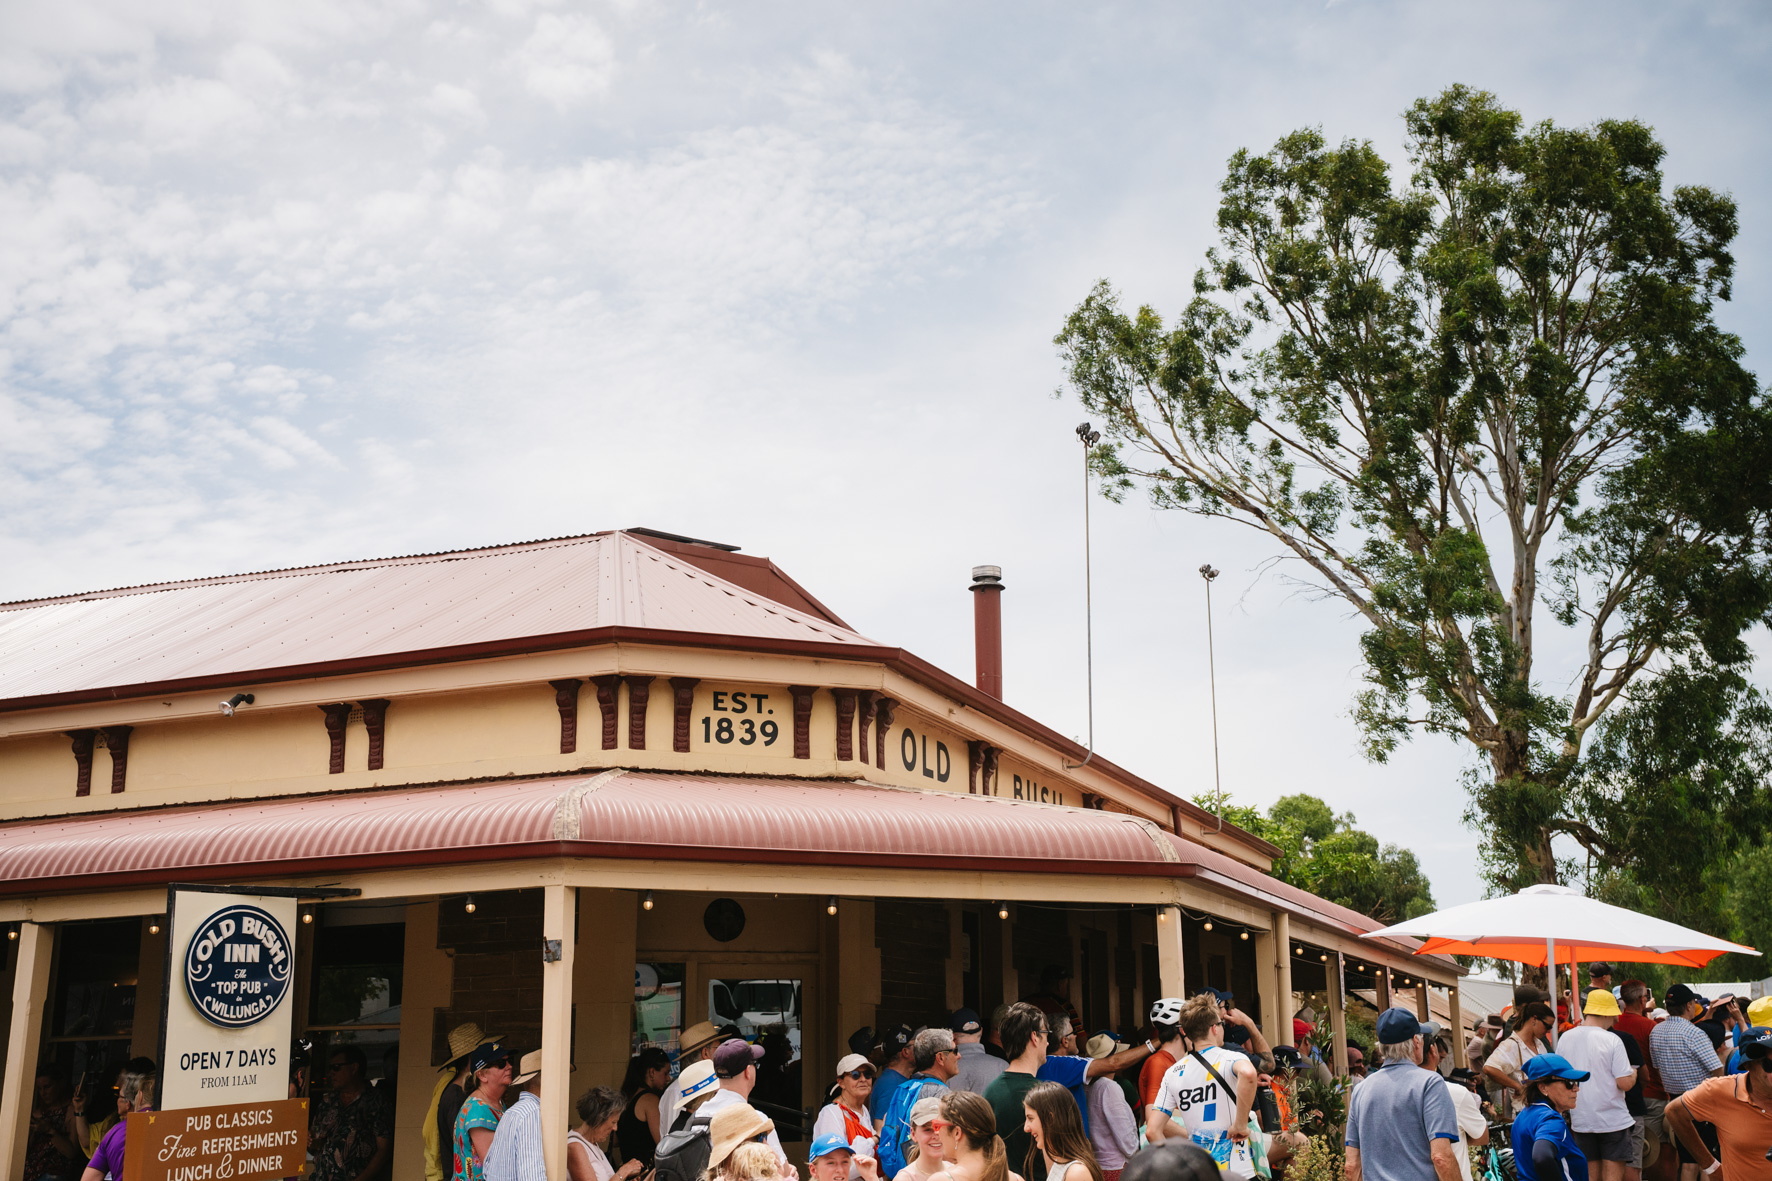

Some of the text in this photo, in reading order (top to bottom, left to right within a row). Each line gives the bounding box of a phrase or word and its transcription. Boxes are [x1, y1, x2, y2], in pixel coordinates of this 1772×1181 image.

[713, 691, 774, 715] EST.
[702, 717, 779, 747] 1839
[901, 727, 950, 783] OLD
[196, 916, 287, 965] OLD BUSH
[223, 943, 260, 963] INN
[234, 968, 247, 979] The
[210, 998, 267, 1019] WILLUNGA
[1755, 1034, 1772, 1042] LOS
[180, 1048, 276, 1071] OPEN 7 DAYS
[201, 1074, 257, 1089] FROM 11AM
[1178, 1082, 1217, 1112] gan
[186, 1109, 273, 1132] PUB CLASSICS
[158, 1130, 298, 1162] Fine REFRESHMENTS
[166, 1153, 283, 1181] LUNCH & DINNER
